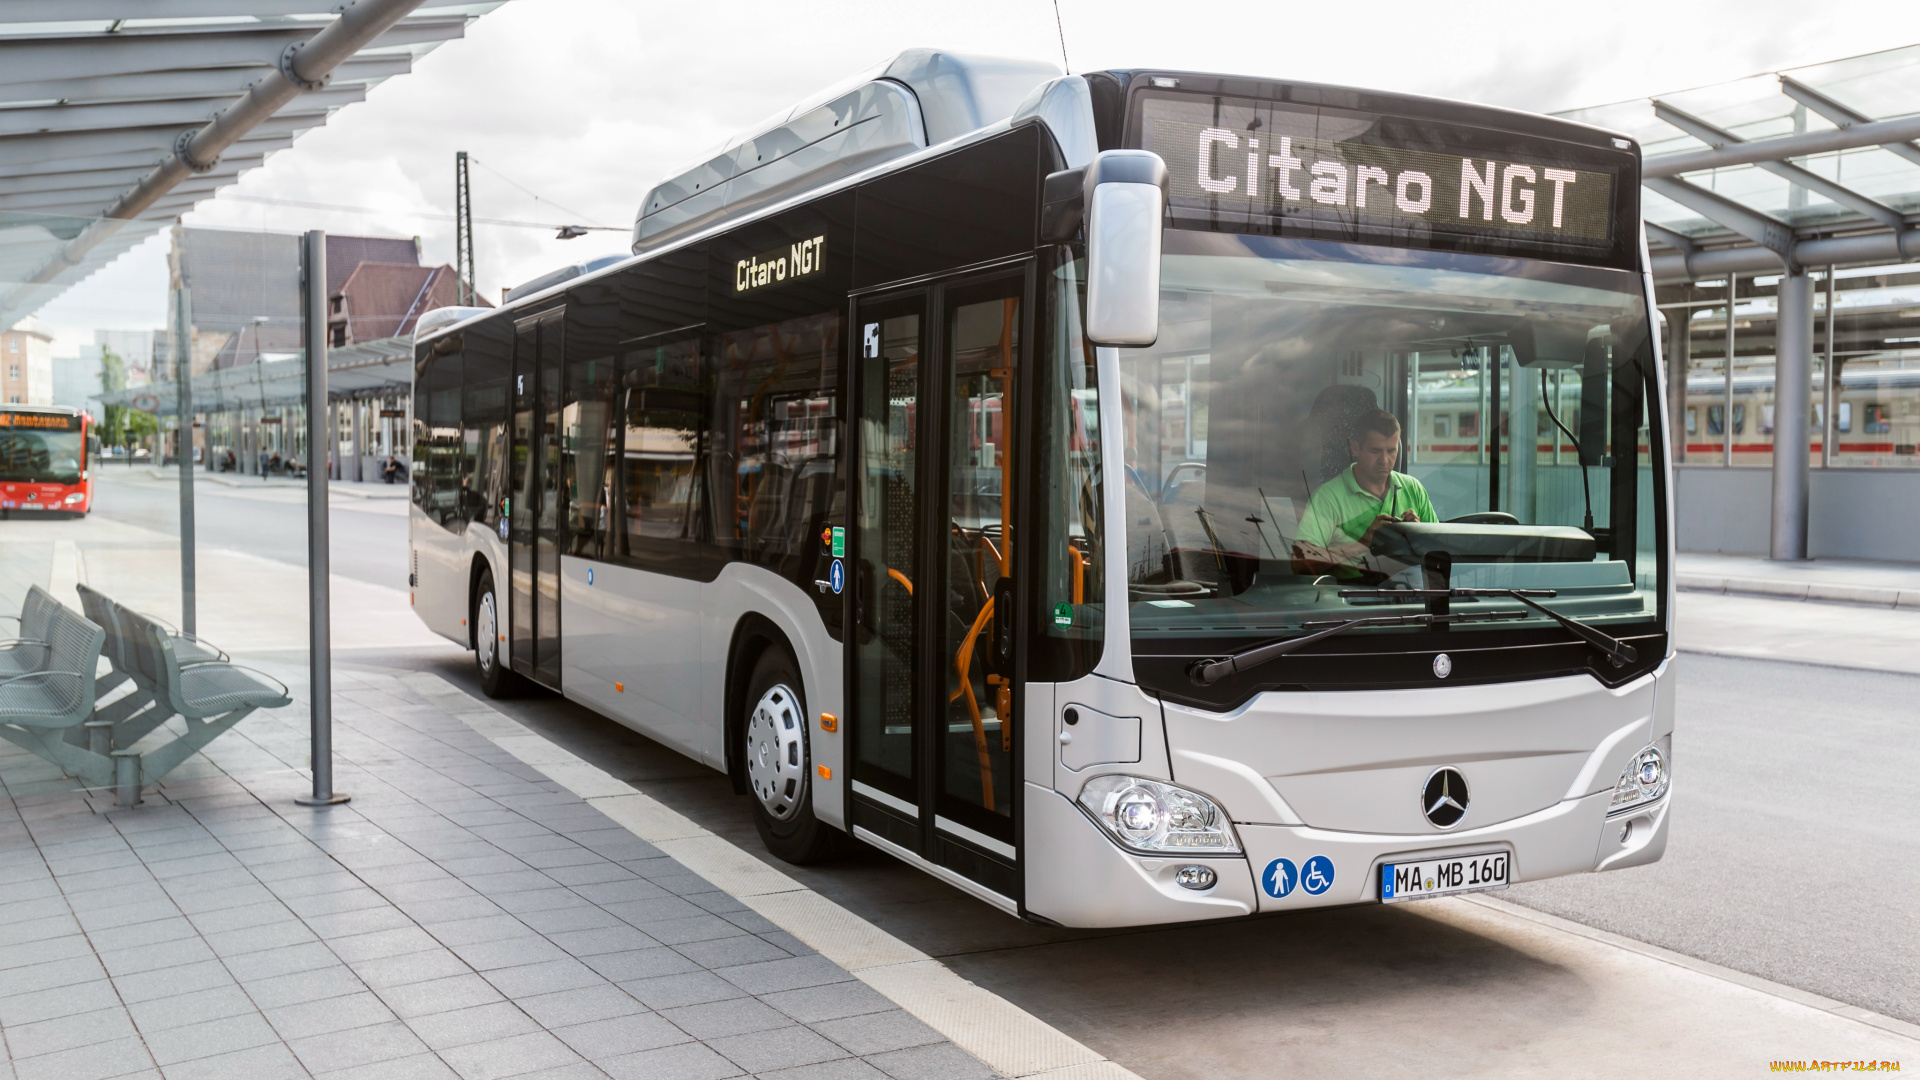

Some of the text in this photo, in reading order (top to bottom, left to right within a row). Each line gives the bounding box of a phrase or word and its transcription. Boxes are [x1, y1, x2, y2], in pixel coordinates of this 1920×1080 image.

[1198, 127, 1576, 228] Citaro NGT
[736, 235, 824, 292] Citaro NGT
[1060, 604, 1066, 616] 4
[1385, 884, 1391, 893] D
[1395, 857, 1505, 893] MA MB 160
